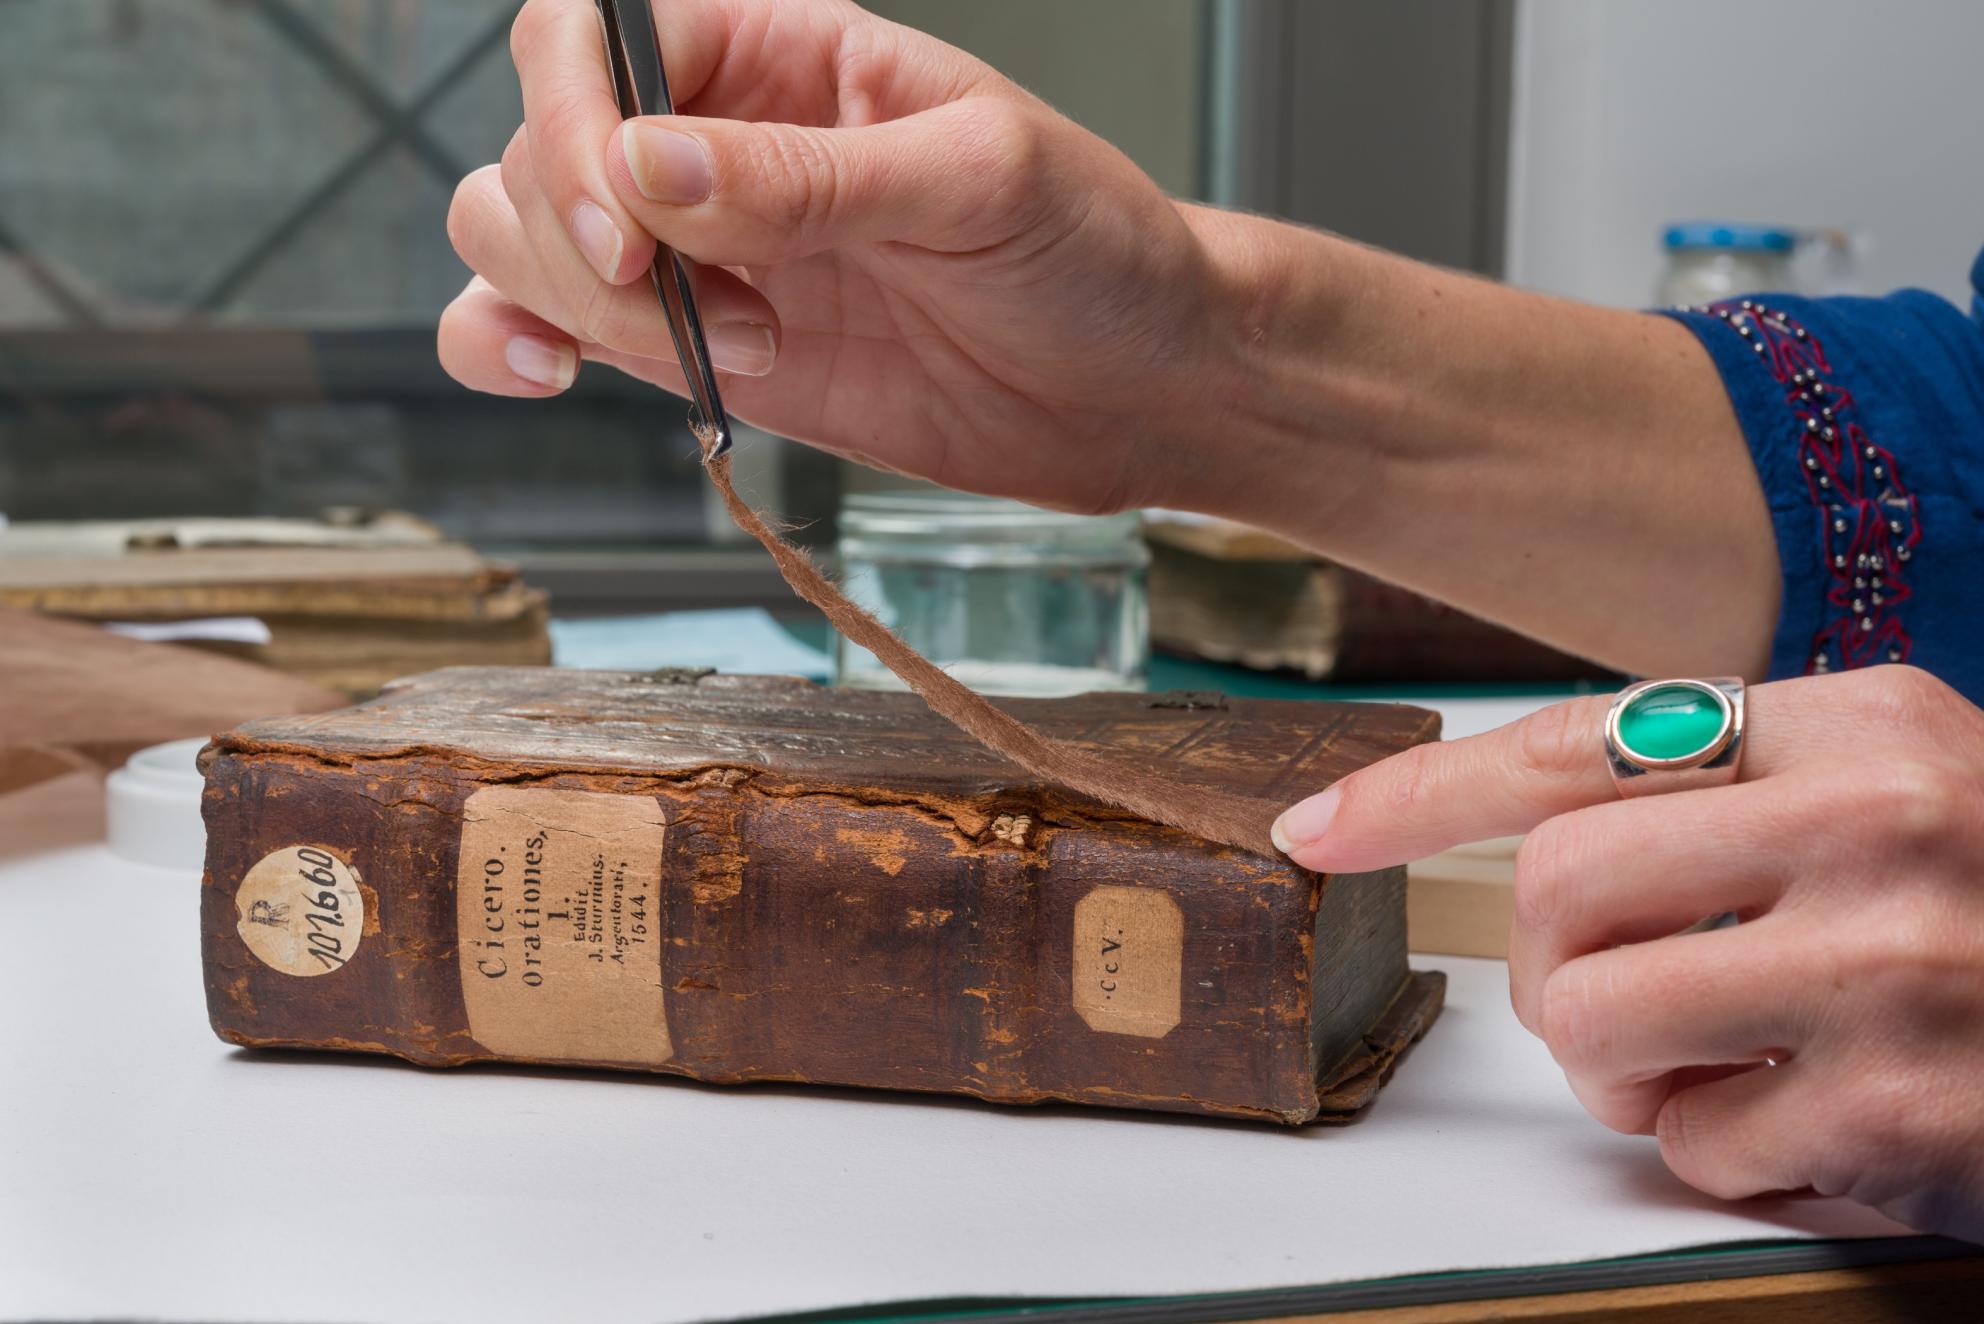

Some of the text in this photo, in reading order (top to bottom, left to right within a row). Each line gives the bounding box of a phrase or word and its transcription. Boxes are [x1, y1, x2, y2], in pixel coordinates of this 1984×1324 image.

[249, 900, 290, 931] R
[477, 847, 507, 979] Cicero.
[572, 889, 589, 942] Edidit
[588, 853, 604, 963] J. Sturmius.
[630, 883, 648, 944] 1544.
